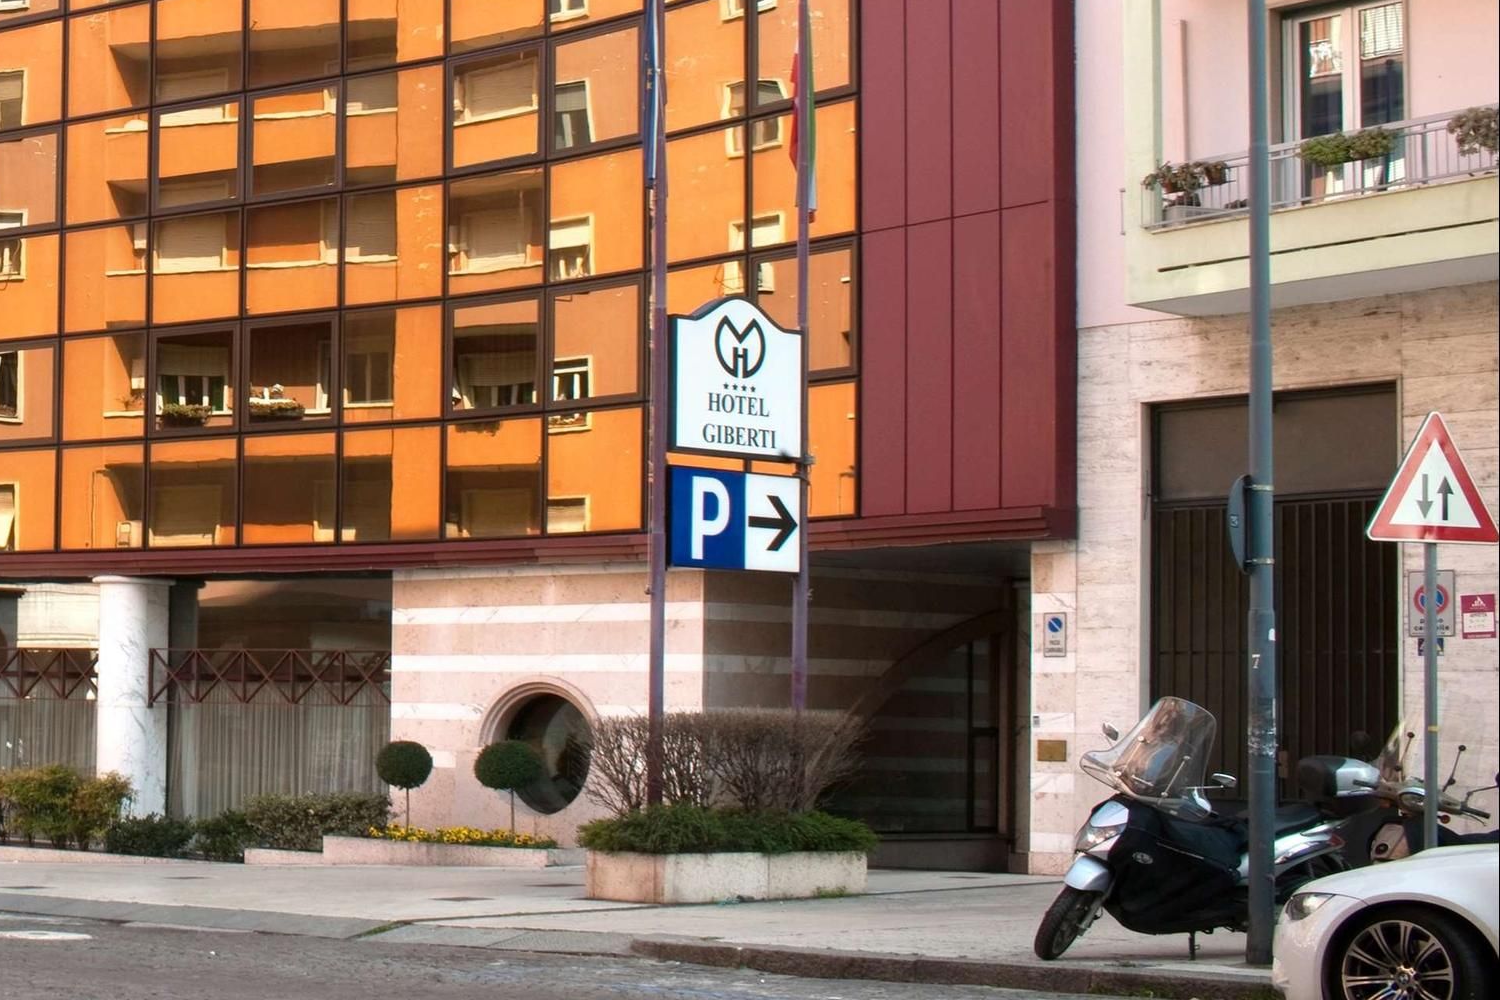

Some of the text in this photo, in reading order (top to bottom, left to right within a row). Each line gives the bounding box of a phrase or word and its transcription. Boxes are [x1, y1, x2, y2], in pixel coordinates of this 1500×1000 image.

[707, 392, 771, 418] HOTEL
[702, 423, 777, 449] GIBERTI
[691, 475, 730, 560] P
